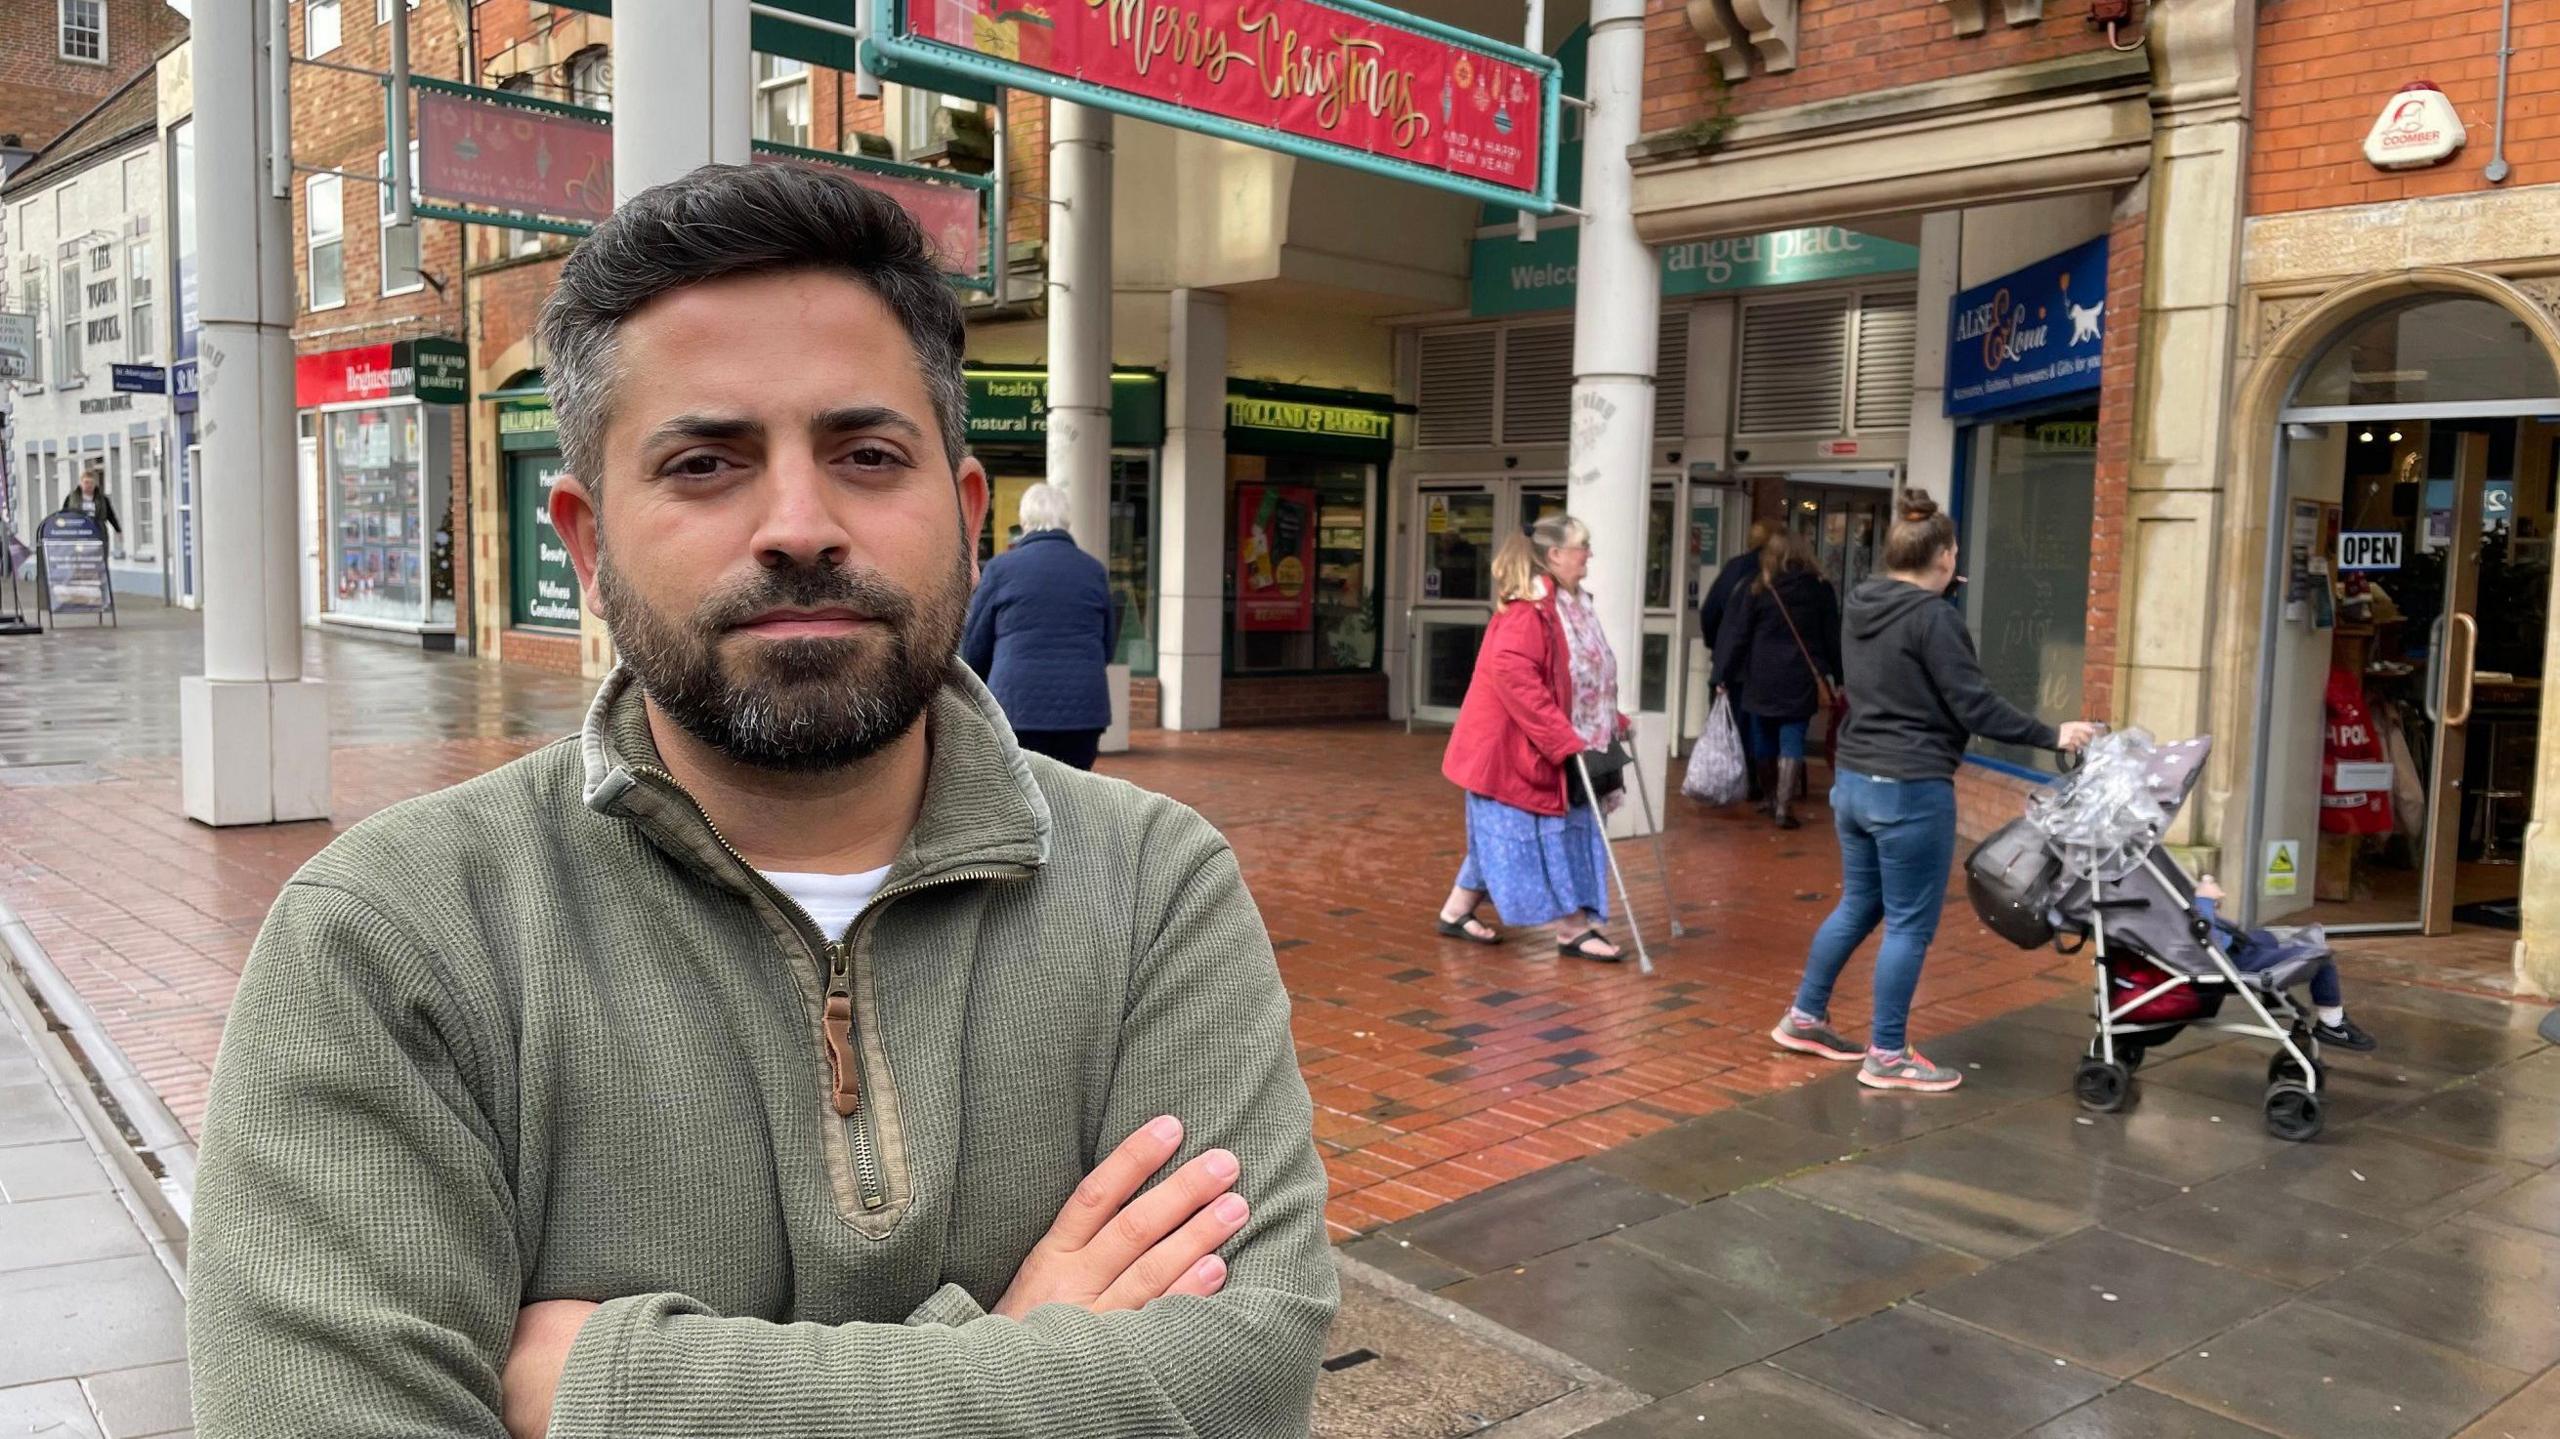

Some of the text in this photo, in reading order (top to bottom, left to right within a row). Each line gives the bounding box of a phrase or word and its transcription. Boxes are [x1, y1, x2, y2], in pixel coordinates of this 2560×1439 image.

[1073, 0, 1430, 147] Merry Christmas
[1442, 130, 1523, 161] AND A HAPPY
[2383, 130, 2440, 146] COOMBER
[1448, 147, 1476, 165] NEW
[90, 244, 112, 272] THE
[1668, 226, 1863, 283] angel place
[1511, 262, 1577, 290] Welco
[86, 278, 118, 309] TOWN
[87, 315, 122, 345] HOTEL
[419, 353, 466, 369] HOLLAND
[420, 374, 464, 391] BARRETT
[987, 381, 1037, 396] health
[1030, 398, 1044, 414] &
[970, 416, 1027, 431] natural
[1231, 401, 1391, 439] HOLLAND & BARRETT
[540, 542, 567, 568] Beauty
[2343, 536, 2397, 565] OPEN
[538, 579, 570, 600] Wellness
[530, 598, 580, 621] Consultations
